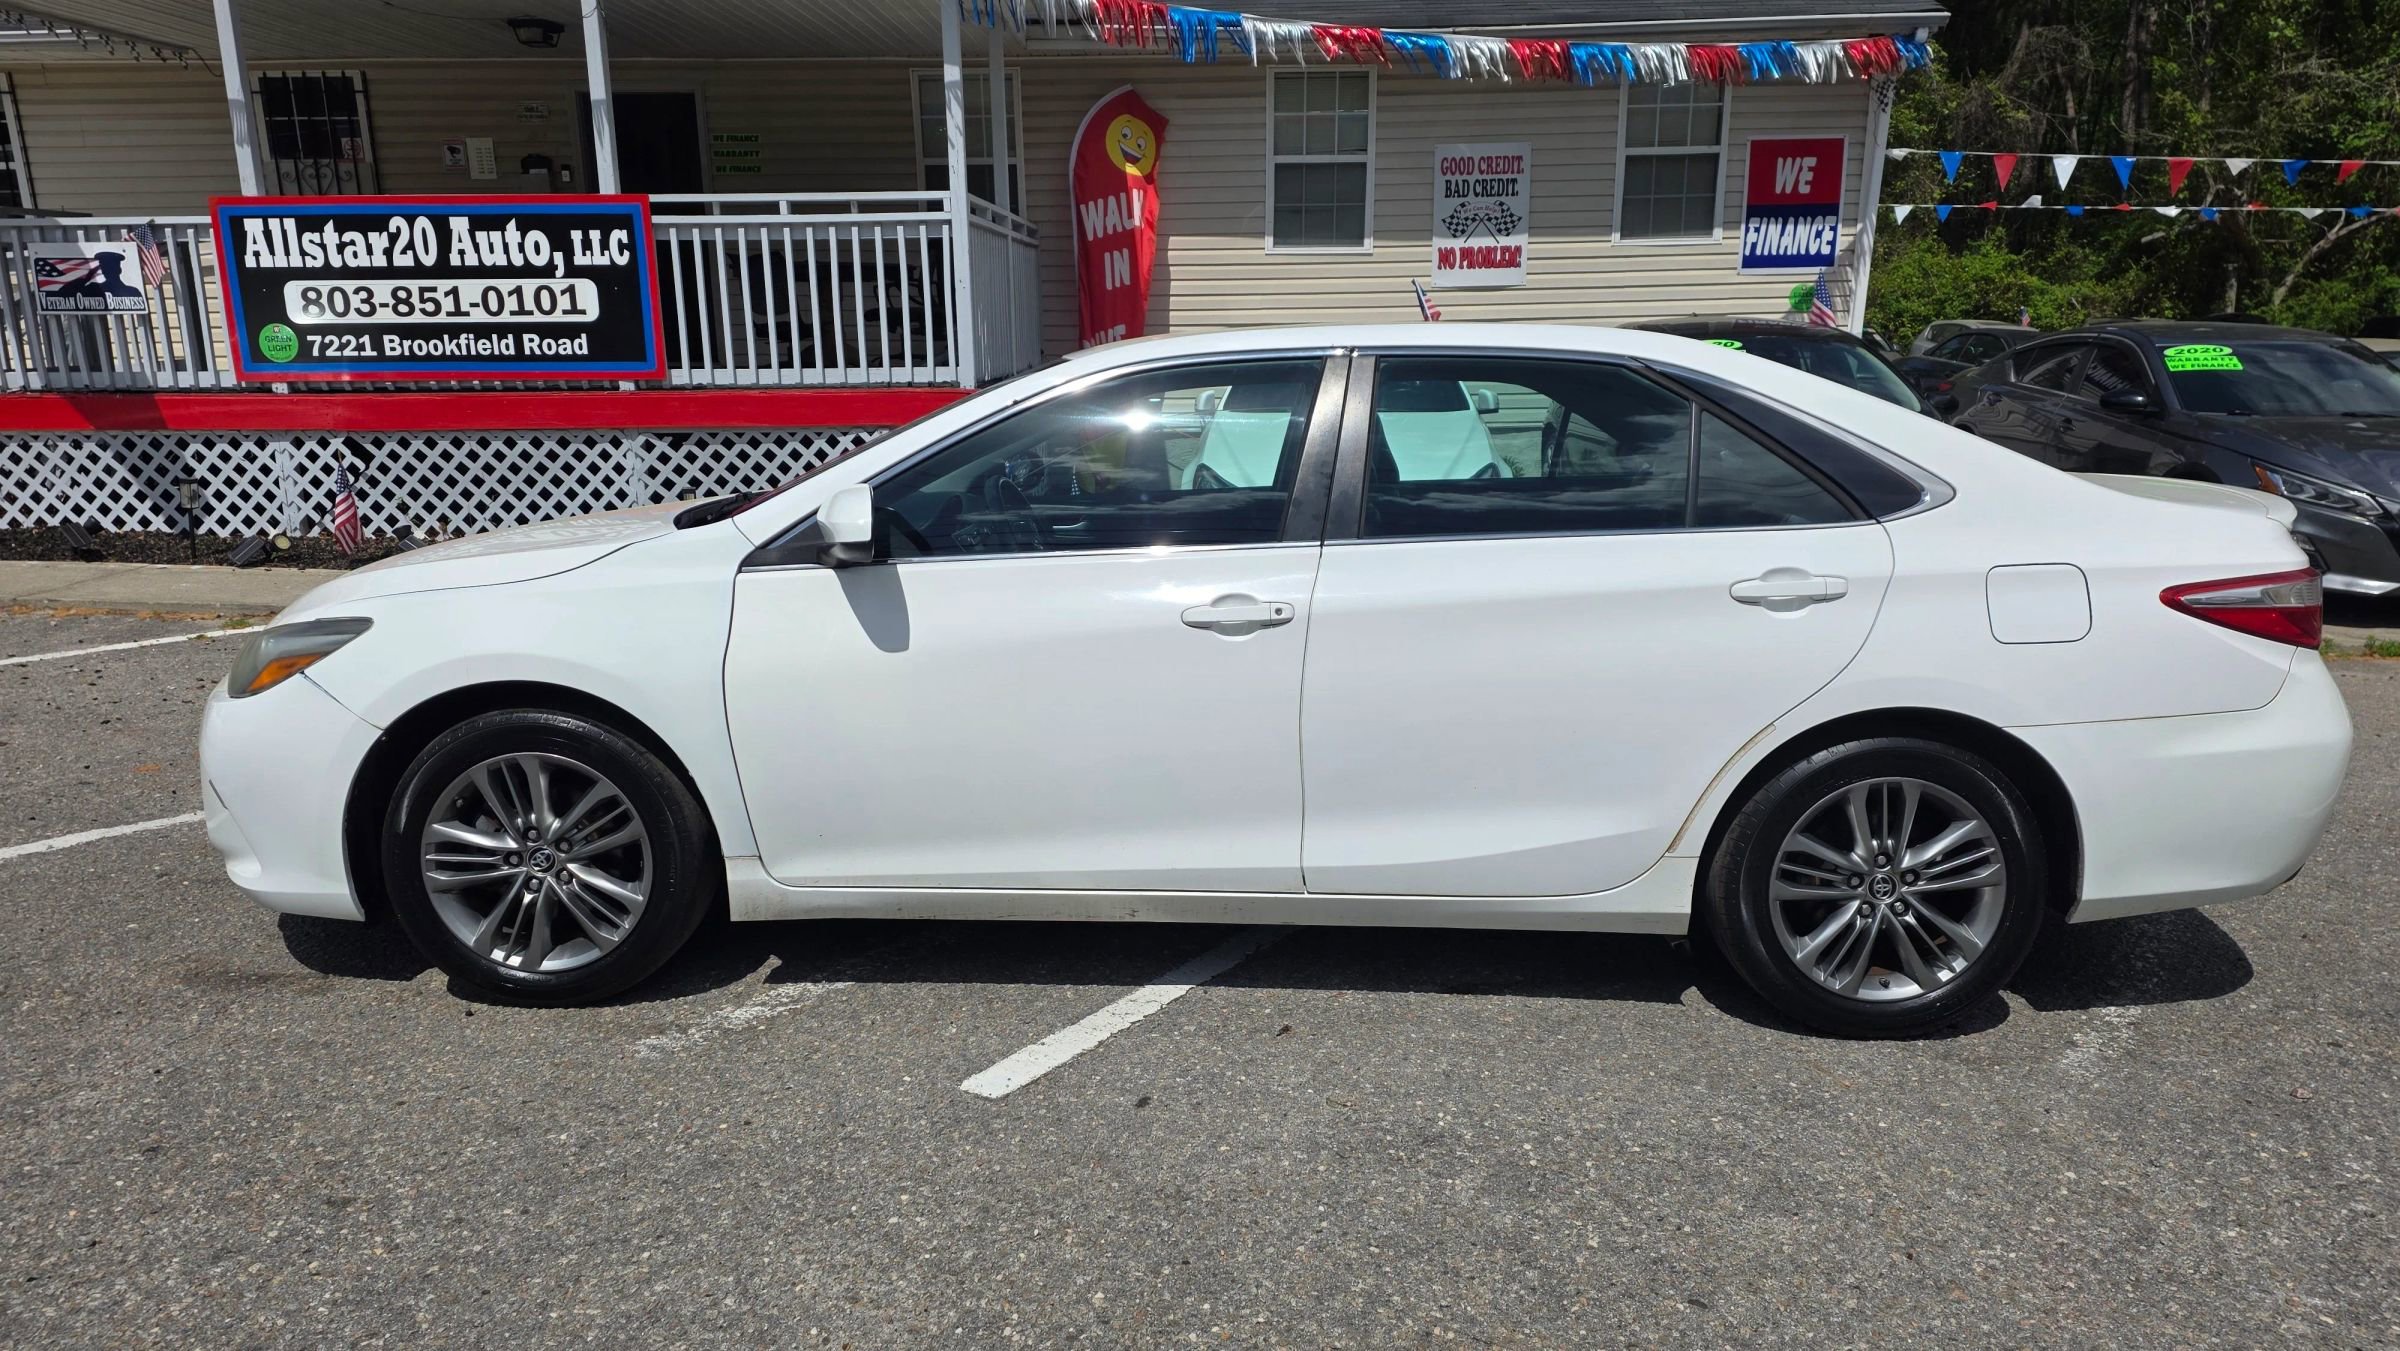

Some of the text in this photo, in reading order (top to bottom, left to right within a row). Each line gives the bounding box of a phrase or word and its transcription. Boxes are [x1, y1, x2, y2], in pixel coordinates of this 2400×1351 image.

[1441, 155, 1525, 176] GOOD CREDIT.
[1775, 156, 1818, 194] WE
[1444, 178, 1519, 198] BAD CREDIT.
[1080, 188, 1145, 242] WALK
[243, 215, 630, 278] Allstar20 Auto, LLC
[1744, 215, 1838, 256] FINANCE
[1103, 247, 1131, 291] IN
[1437, 244, 1522, 270] NO PROBLEM!
[39, 291, 145, 310] VETERAN OWNED BUSINESS
[301, 284, 587, 318] 803-851-0101
[264, 335, 292, 343] GREEN
[268, 344, 293, 352] LIGHT
[306, 333, 589, 357] 7221 Brookfield Road
[2173, 346, 2224, 355] 2020
